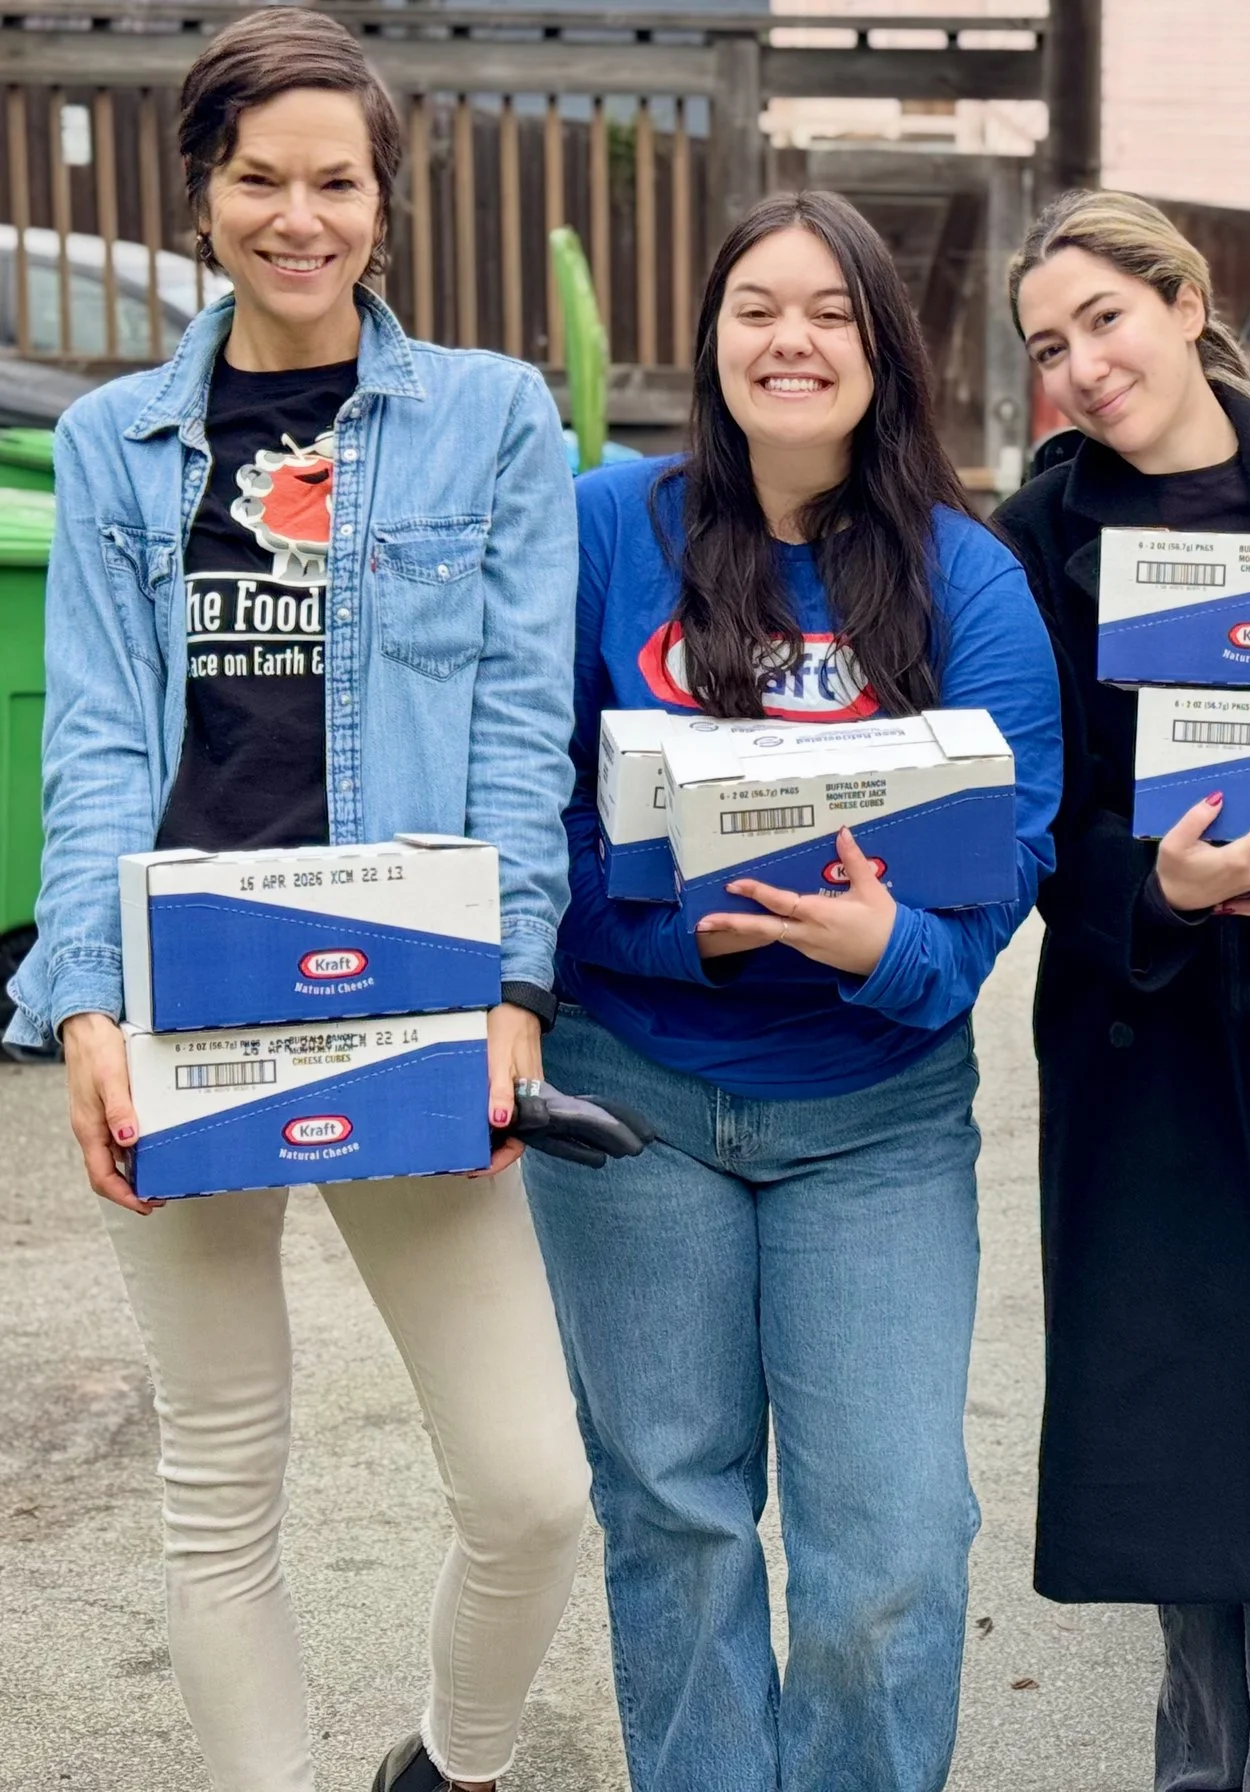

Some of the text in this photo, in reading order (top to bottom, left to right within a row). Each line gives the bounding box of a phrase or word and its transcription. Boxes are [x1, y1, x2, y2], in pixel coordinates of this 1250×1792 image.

[1150, 542, 1155, 550] 2
[1157, 542, 1166, 550] OZ
[187, 580, 321, 632] he Food
[189, 645, 324, 678] ace on Earth &
[756, 653, 838, 701] aft
[1192, 701, 1202, 709] OZ
[1231, 702, 1250, 711] PKGS
[732, 791, 737, 799] 2
[739, 790, 749, 799] OZ
[780, 786, 800, 795] PKGS
[825, 779, 887, 792] BUFFALO RANCH
[825, 788, 887, 801] MONTEREY JACK
[829, 799, 885, 810] CHEESE CUBES
[240, 876, 254, 891] 16
[262, 874, 286, 890] APR
[293, 871, 323, 887] 2026
[361, 867, 378, 882] 22
[387, 865, 404, 880] 13
[315, 956, 351, 971] Kraft
[294, 976, 375, 995] Natural Cheese
[376, 1031, 392, 1045] 22
[403, 1029, 418, 1043] 14
[189, 1043, 195, 1052] 2
[196, 1042, 206, 1051] OZ
[292, 1054, 351, 1066] CHEESE CUBES
[299, 1122, 336, 1137] Kraft
[279, 1142, 360, 1160] Natural Cheese
